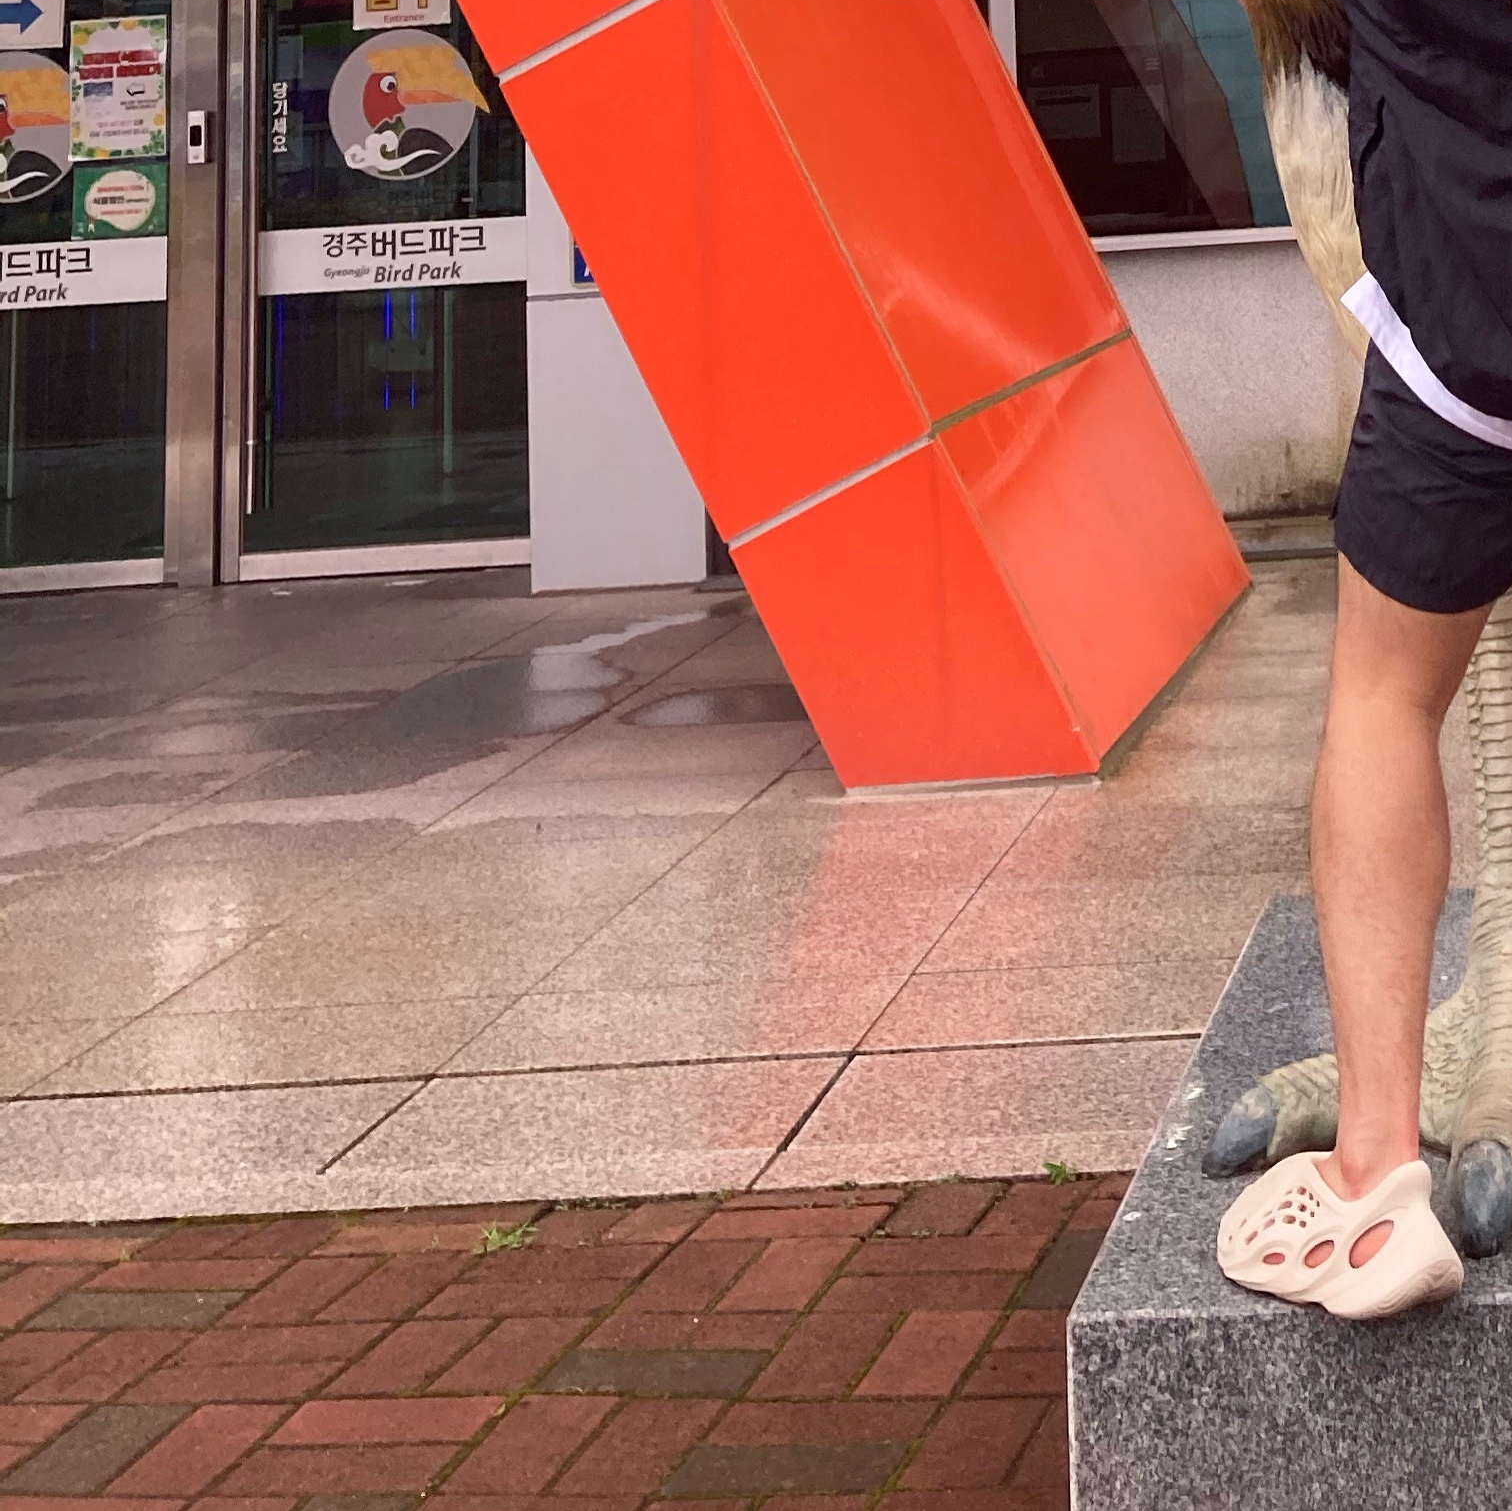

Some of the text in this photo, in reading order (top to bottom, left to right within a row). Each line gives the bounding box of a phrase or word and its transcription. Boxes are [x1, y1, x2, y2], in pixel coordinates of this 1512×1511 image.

[383, 14, 426, 24] Entrance
[272, 81, 289, 154] 당기세요
[322, 225, 487, 260] 경주버드파크
[323, 261, 462, 283] Gyeongju Bird Park
[24, 283, 67, 302] Park
